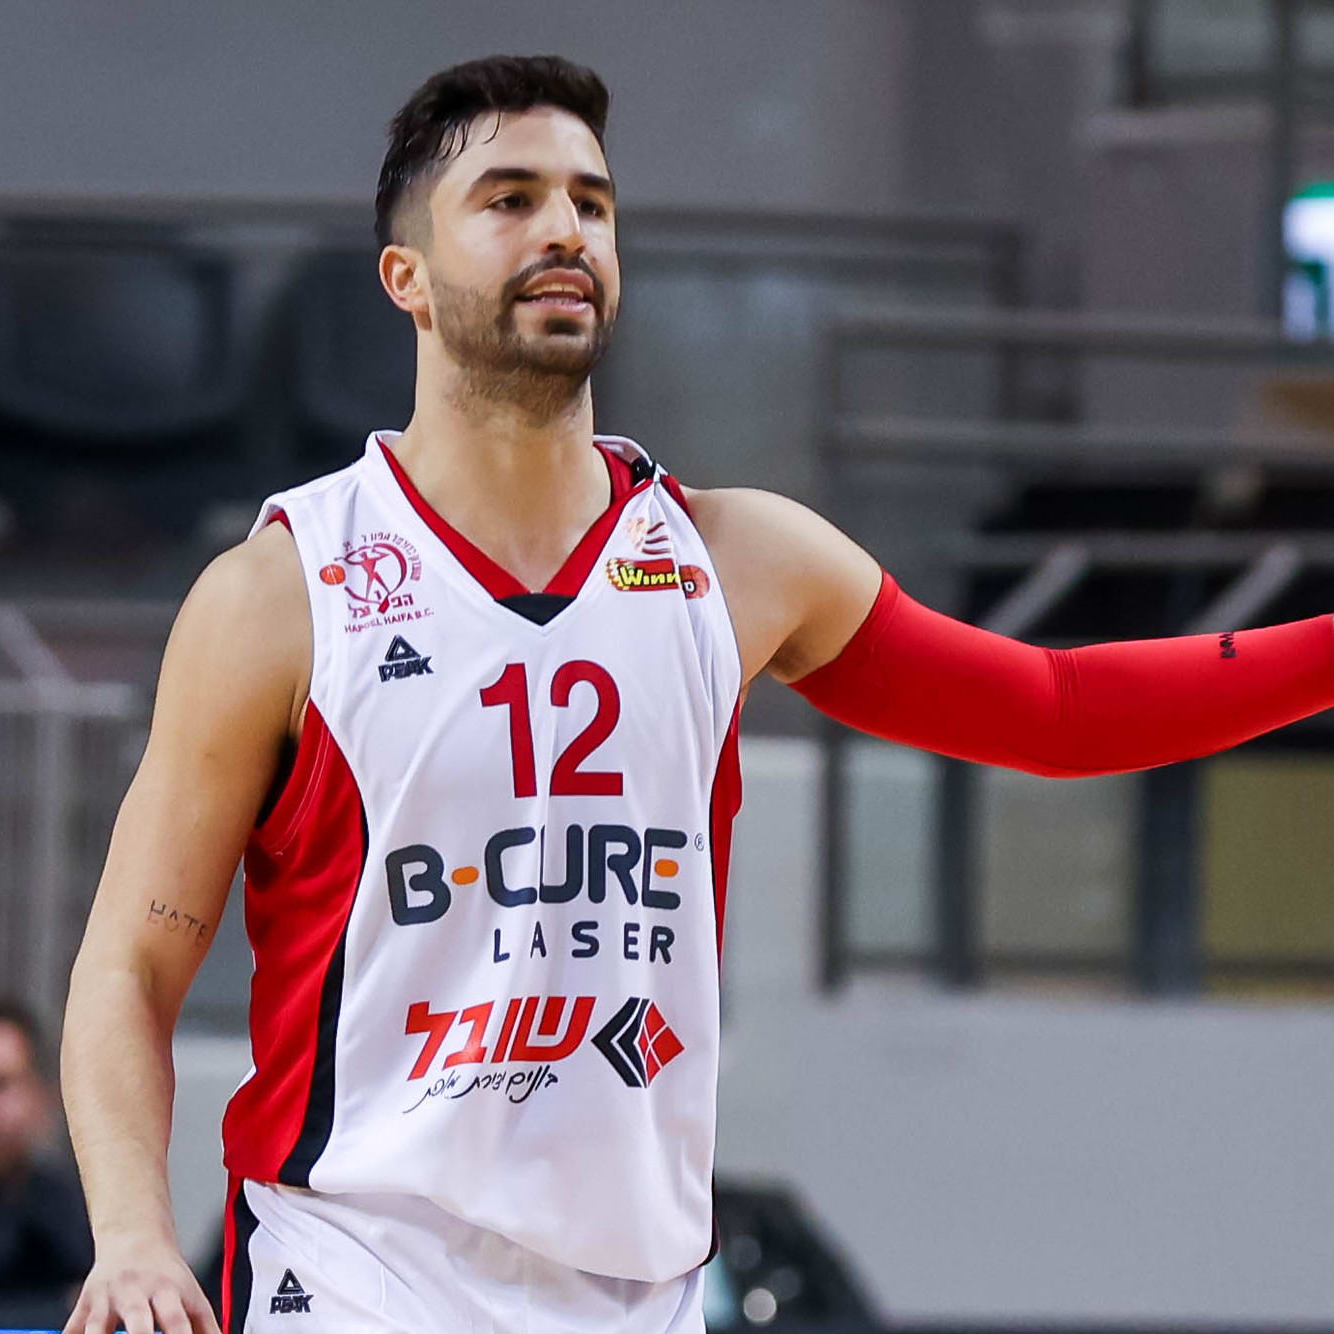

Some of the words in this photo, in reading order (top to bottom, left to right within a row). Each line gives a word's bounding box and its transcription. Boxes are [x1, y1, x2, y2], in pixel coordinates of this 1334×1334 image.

[383, 612, 414, 625] HAIFA
[378, 656, 434, 683] PEAK
[479, 659, 624, 798] 12
[493, 920, 675, 965] LASER
[405, 996, 597, 1081] שובל
[269, 1294, 315, 1314] PEAK
